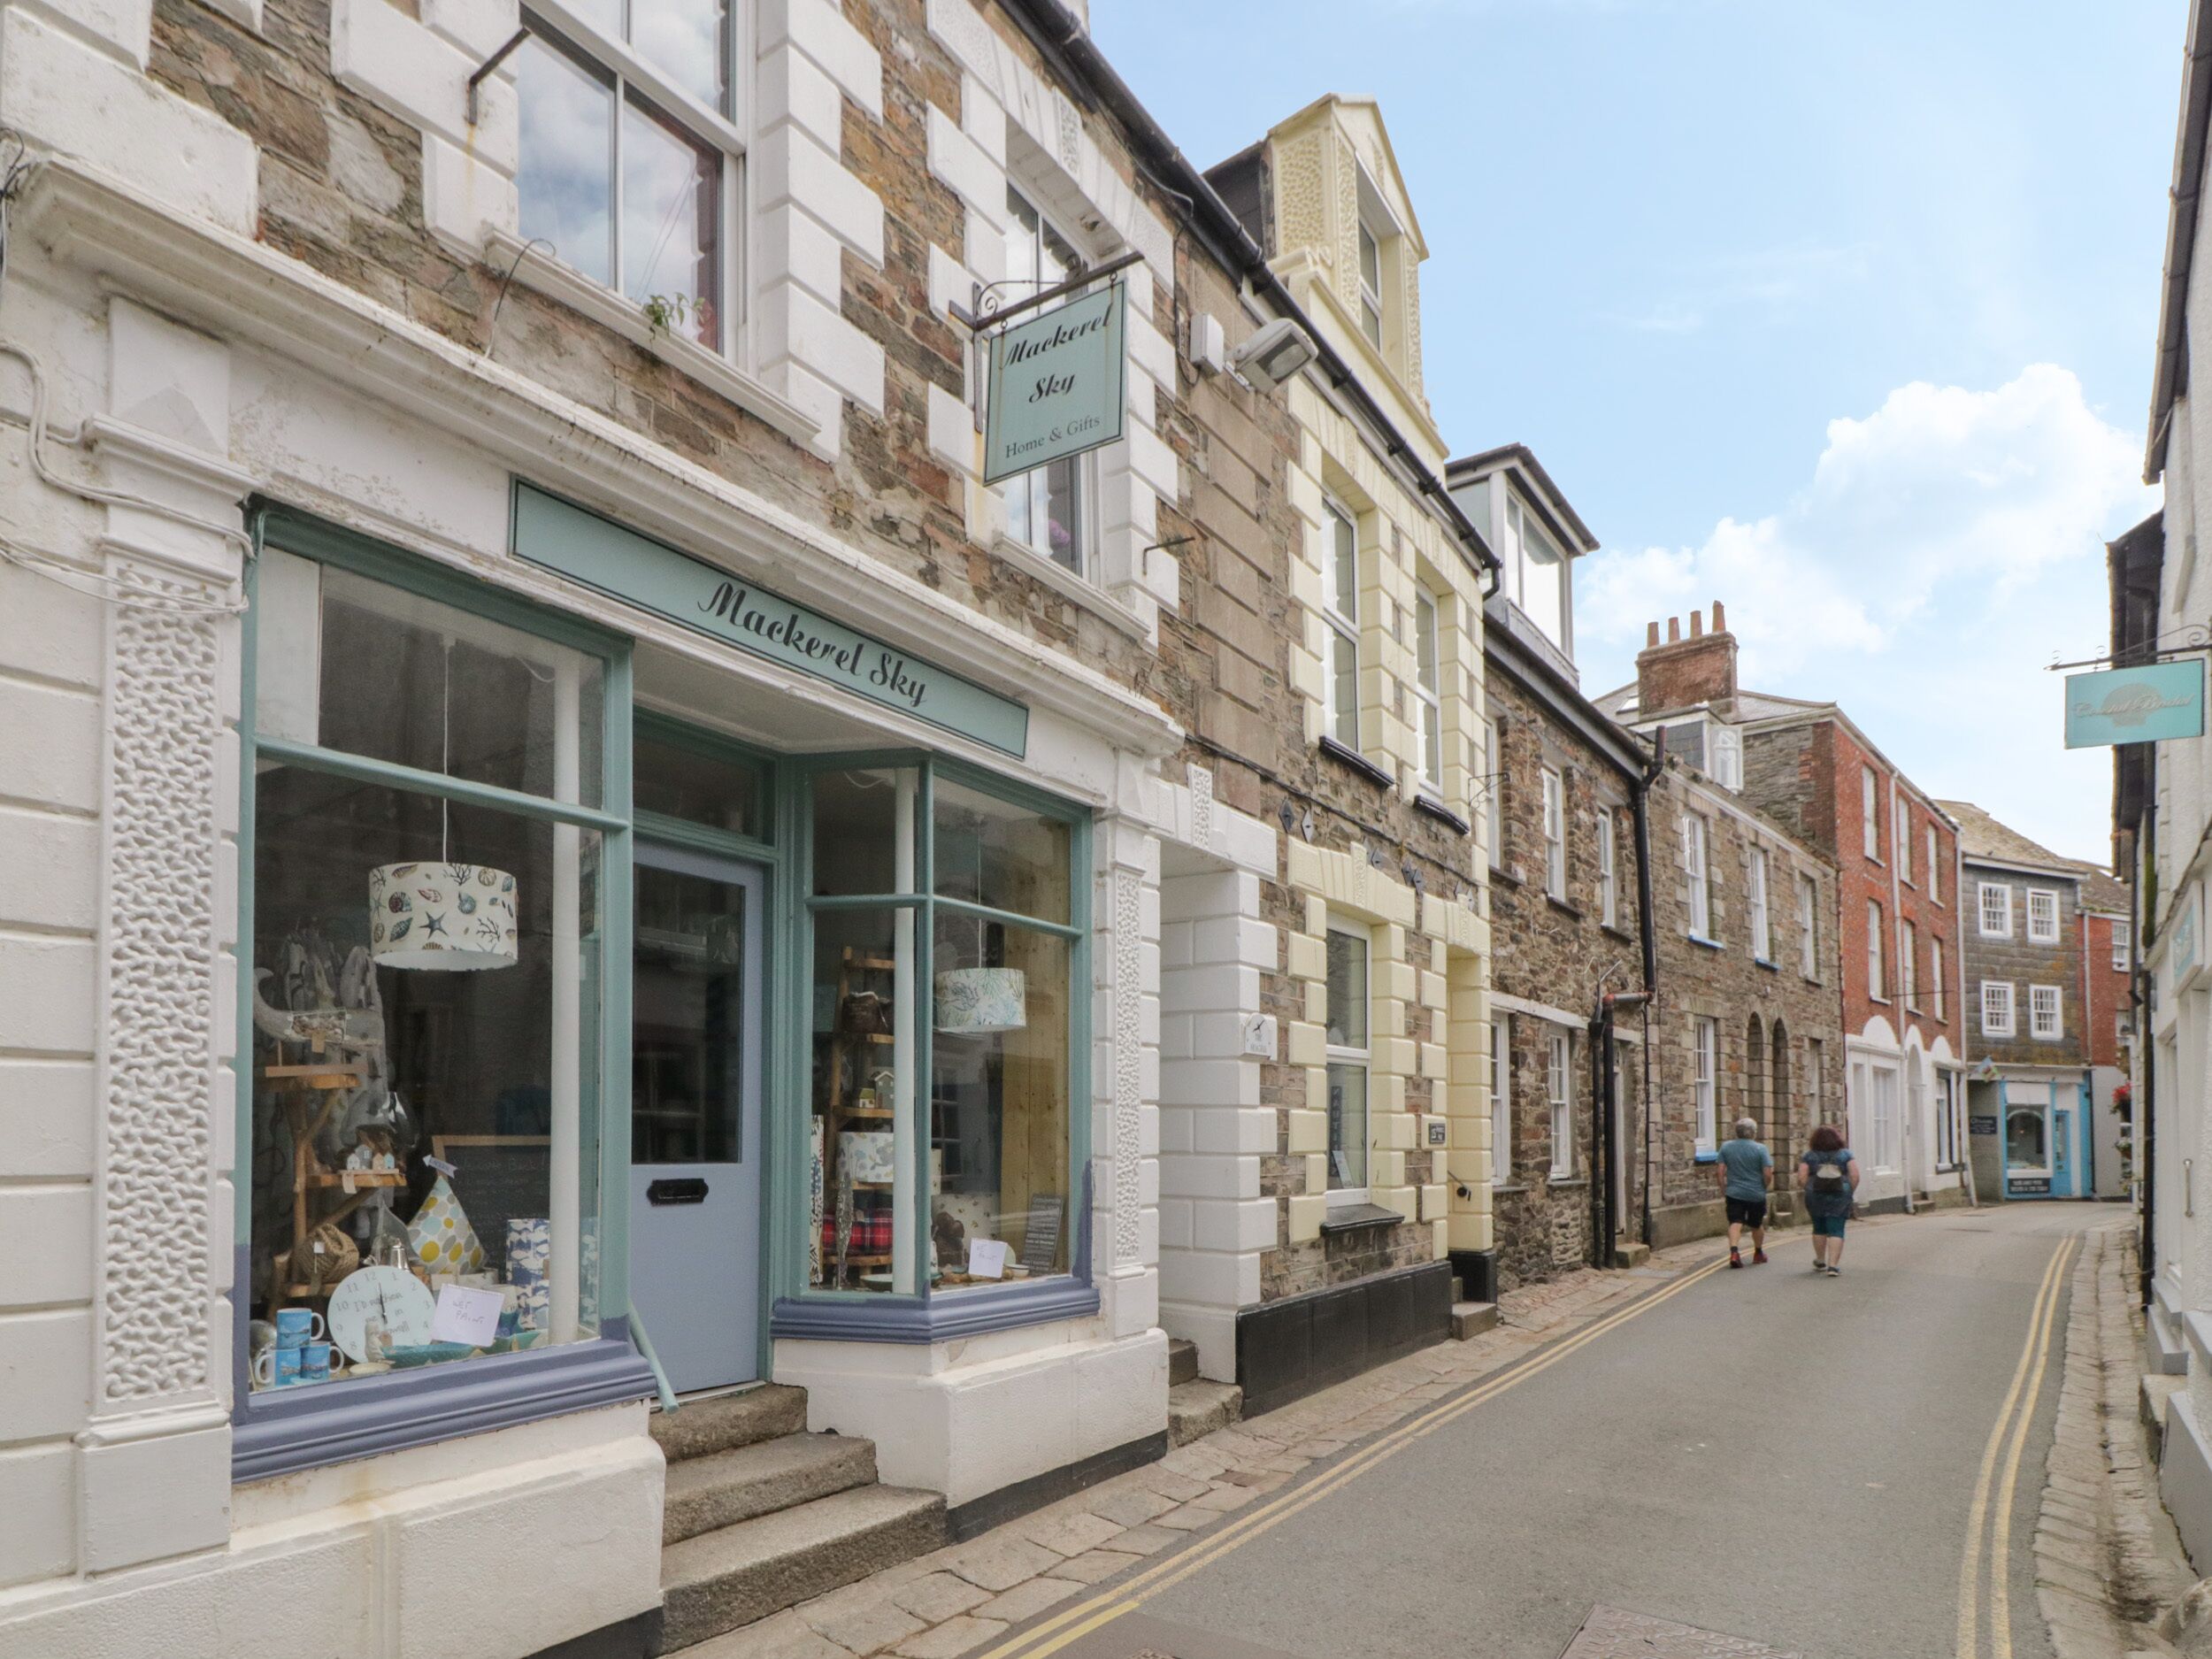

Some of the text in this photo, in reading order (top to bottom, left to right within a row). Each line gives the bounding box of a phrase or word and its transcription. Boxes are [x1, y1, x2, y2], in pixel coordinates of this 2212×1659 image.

[1002, 303, 1112, 368] Mackerel
[1028, 373, 1075, 403] Sky
[1005, 415, 1101, 458] Home & Gifts
[696, 581, 928, 709] Mackerel Sky
